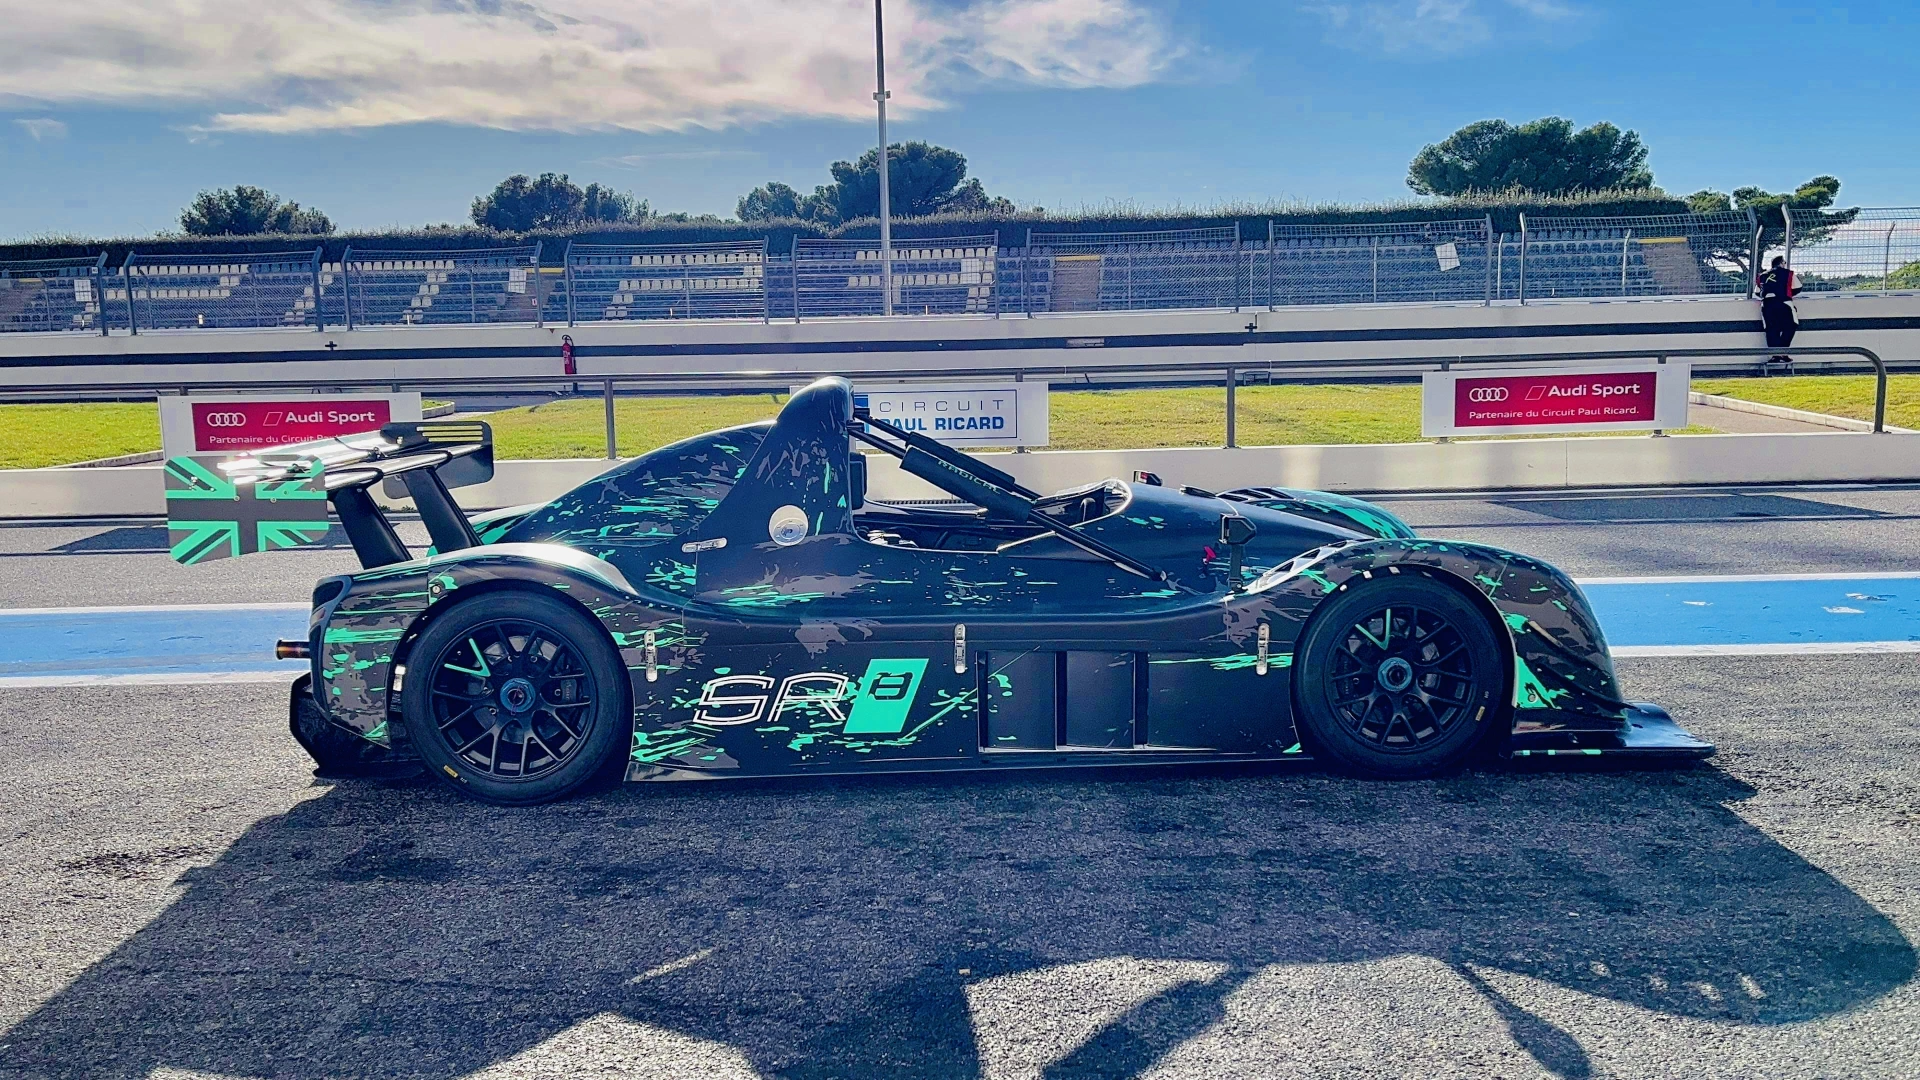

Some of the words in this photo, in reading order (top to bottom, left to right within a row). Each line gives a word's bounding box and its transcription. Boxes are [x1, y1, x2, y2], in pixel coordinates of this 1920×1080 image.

[1547, 384, 1588, 398] Audi
[1591, 383, 1641, 398] Sport
[879, 399, 1004, 413] CIRCUIT
[1469, 411, 1523, 420] Partenaire
[1525, 410, 1540, 418] du
[1541, 408, 1576, 417] Circuit
[1577, 407, 1601, 417] Paul
[1603, 406, 1640, 415] Ricard.
[285, 411, 323, 423] Audi
[327, 410, 376, 426] Sport
[934, 416, 1005, 431] RICARD
[209, 435, 263, 444] Partenaire
[265, 434, 279, 444] du
[281, 434, 314, 443] Circuit
[937, 460, 1001, 495] RADICAL
